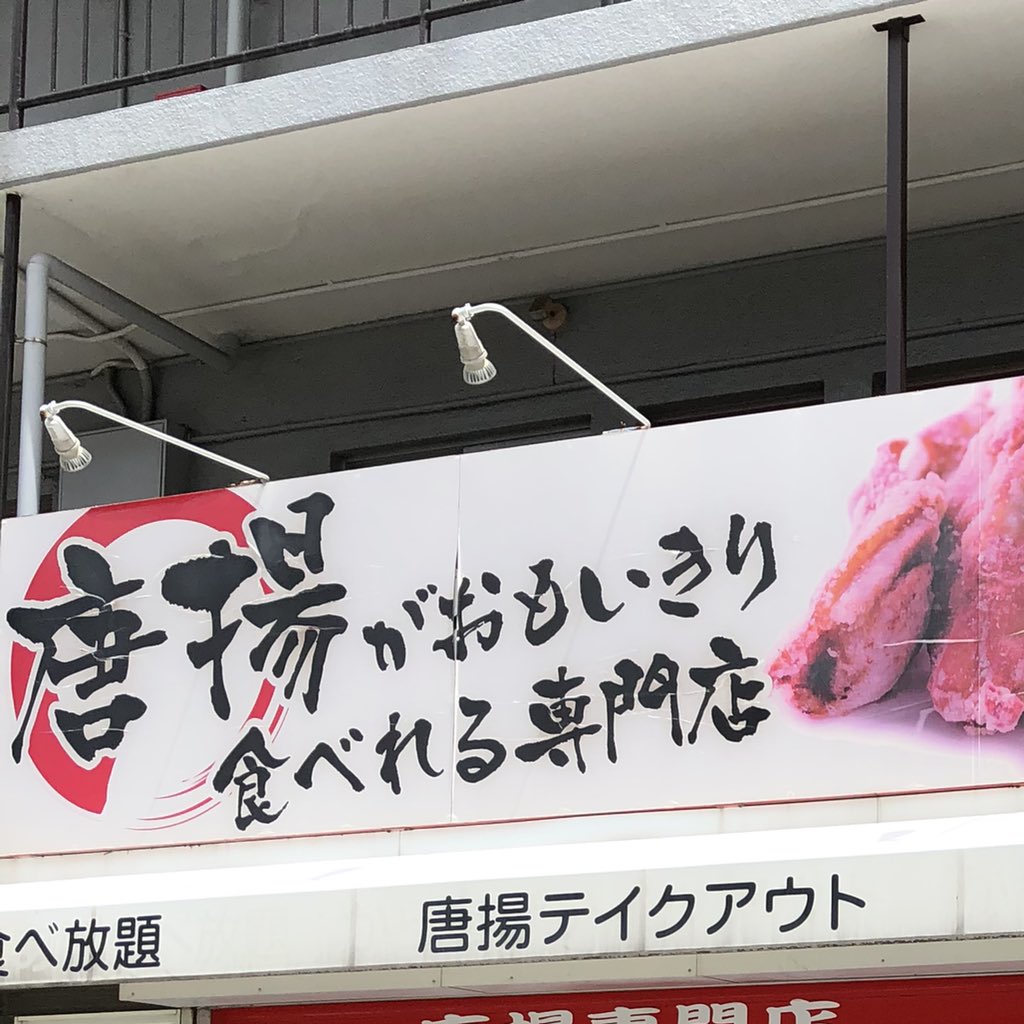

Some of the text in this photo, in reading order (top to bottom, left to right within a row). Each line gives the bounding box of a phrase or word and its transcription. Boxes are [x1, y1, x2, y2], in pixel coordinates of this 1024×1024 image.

[213, 636, 771, 831] 食べれる専門店
[417, 873, 866, 955] 唐揚テイクアウト
